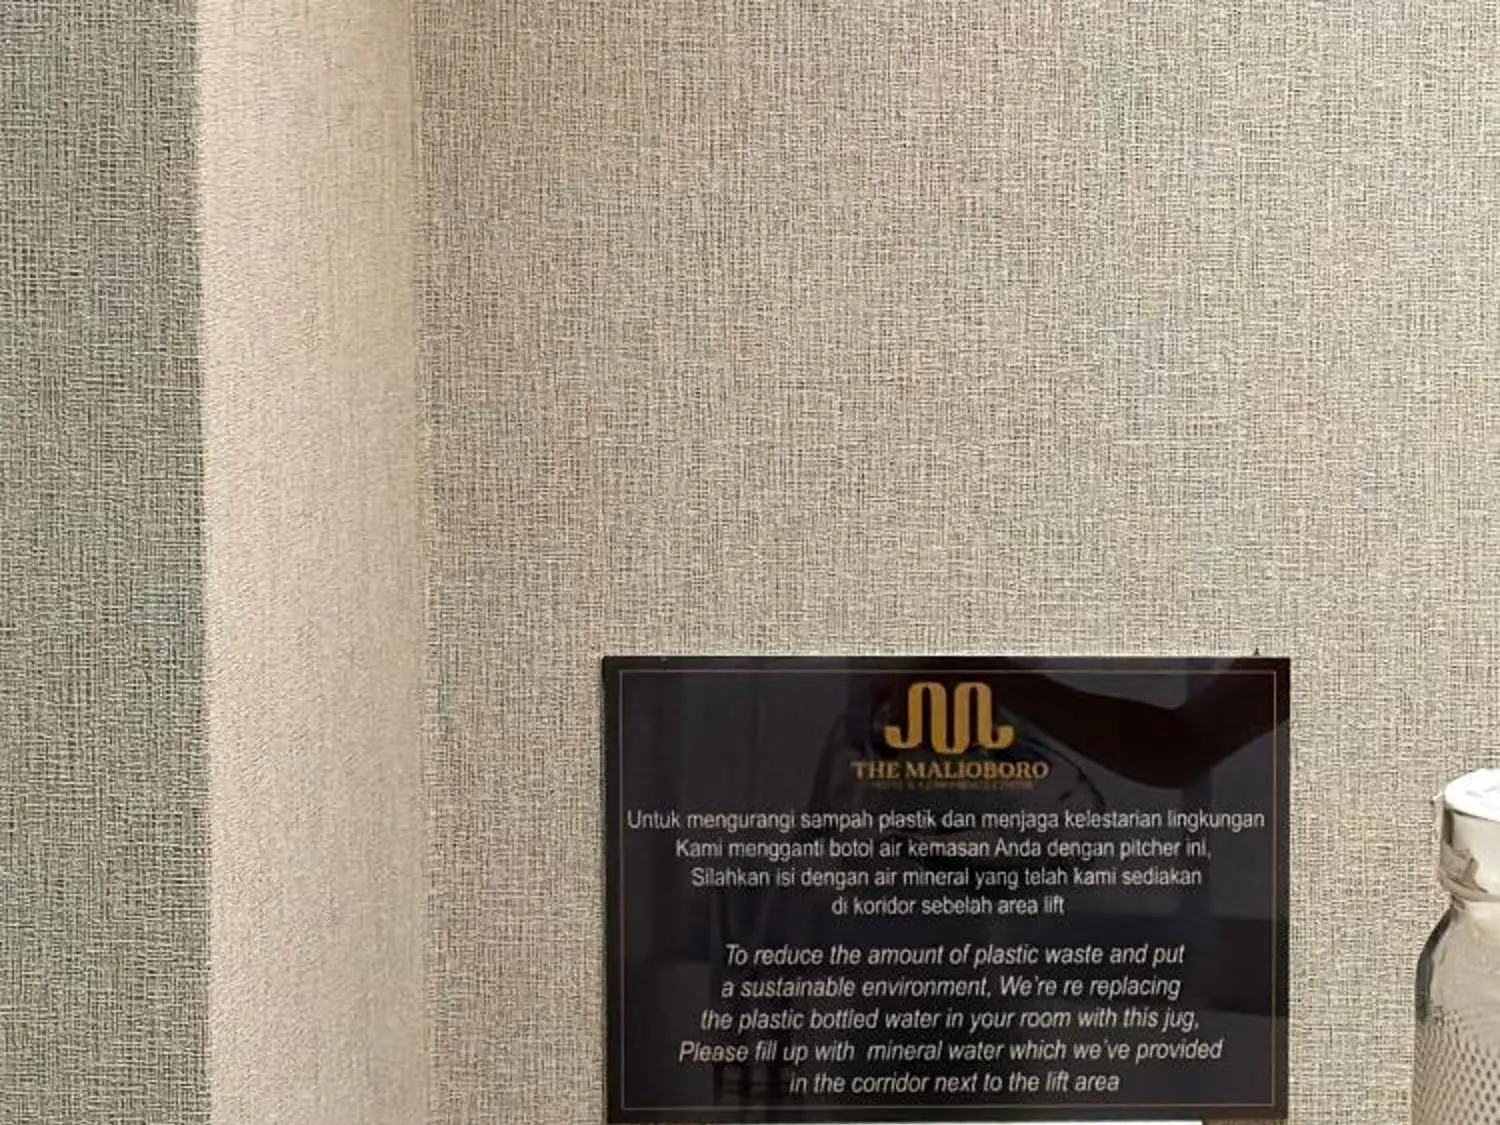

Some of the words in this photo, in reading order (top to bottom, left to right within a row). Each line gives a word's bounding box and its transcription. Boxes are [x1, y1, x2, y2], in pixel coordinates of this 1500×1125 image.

[850, 760, 900, 780] THE
[904, 760, 1050, 780] MALIOBORO
[626, 808, 681, 830] Untuk
[686, 809, 796, 833] mengurangi
[800, 809, 874, 833] sampah
[877, 808, 937, 833] plastik
[940, 808, 977, 829] dan
[981, 808, 1059, 833] menjaga
[1063, 808, 1163, 829] kelestarian
[1167, 808, 1265, 833] lingkungan
[675, 837, 723, 858] Kami
[728, 839, 825, 863] mengganti
[829, 837, 875, 858] botol
[878, 838, 903, 858] air
[908, 837, 991, 858] kemasan
[993, 836, 1042, 858] Anda
[1046, 838, 1115, 862] dengan
[1119, 837, 1182, 861] pitcher
[690, 866, 771, 888] Silahkan
[775, 867, 796, 887] isi
[800, 866, 869, 891] dengan
[873, 866, 899, 887] air
[902, 867, 969, 887] mineral
[974, 869, 1019, 891] yang
[1024, 866, 1068, 886] telah
[1073, 866, 1117, 886] kami
[1120, 865, 1202, 886] sediakan
[831, 895, 849, 916] di
[852, 895, 917, 916] koridor
[920, 894, 993, 916] sebelah
[996, 898, 1039, 916] area
[1042, 893, 1066, 916] lift
[725, 943, 750, 966] To
[752, 943, 825, 966] reduce
[829, 943, 863, 966] the
[867, 944, 945, 966] amount
[948, 942, 972, 965] of
[973, 943, 1040, 970] plastic
[1044, 943, 1105, 966] waste
[1109, 943, 1150, 965] and
[1152, 943, 1186, 969] put
[720, 980, 735, 999] a
[739, 975, 857, 999] sustainable
[999, 975, 1058, 997] We're
[1062, 979, 1084, 997] re
[1088, 974, 1182, 1002] replacing
[700, 1008, 734, 1031] the
[737, 1007, 805, 1035] plastic
[809, 1007, 880, 1030] bottled
[884, 1008, 943, 1030] water
[945, 1006, 965, 1029] in
[968, 1010, 1016, 1035] your
[1018, 1010, 1072, 1029] room
[1077, 1005, 1119, 1029] with
[1122, 1006, 1160, 1029] this
[678, 1039, 749, 1063] Please
[753, 1039, 779, 1062] fill
[783, 1044, 809, 1067] up
[814, 1039, 855, 1062] with
[866, 1039, 944, 1062] mineral
[947, 1040, 1006, 1061] water
[1009, 1038, 1068, 1061] which
[1072, 1038, 1131, 1061] we've
[1134, 1037, 1225, 1065] provided
[788, 1071, 808, 1094] in
[812, 1071, 847, 1094] the
[850, 1071, 931, 1094] corridor
[933, 1071, 979, 1093] next
[983, 1072, 1003, 1093] to
[1008, 1071, 1041, 1093] the
[1044, 1069, 1071, 1093] lift
[1073, 1074, 1121, 1093] area
